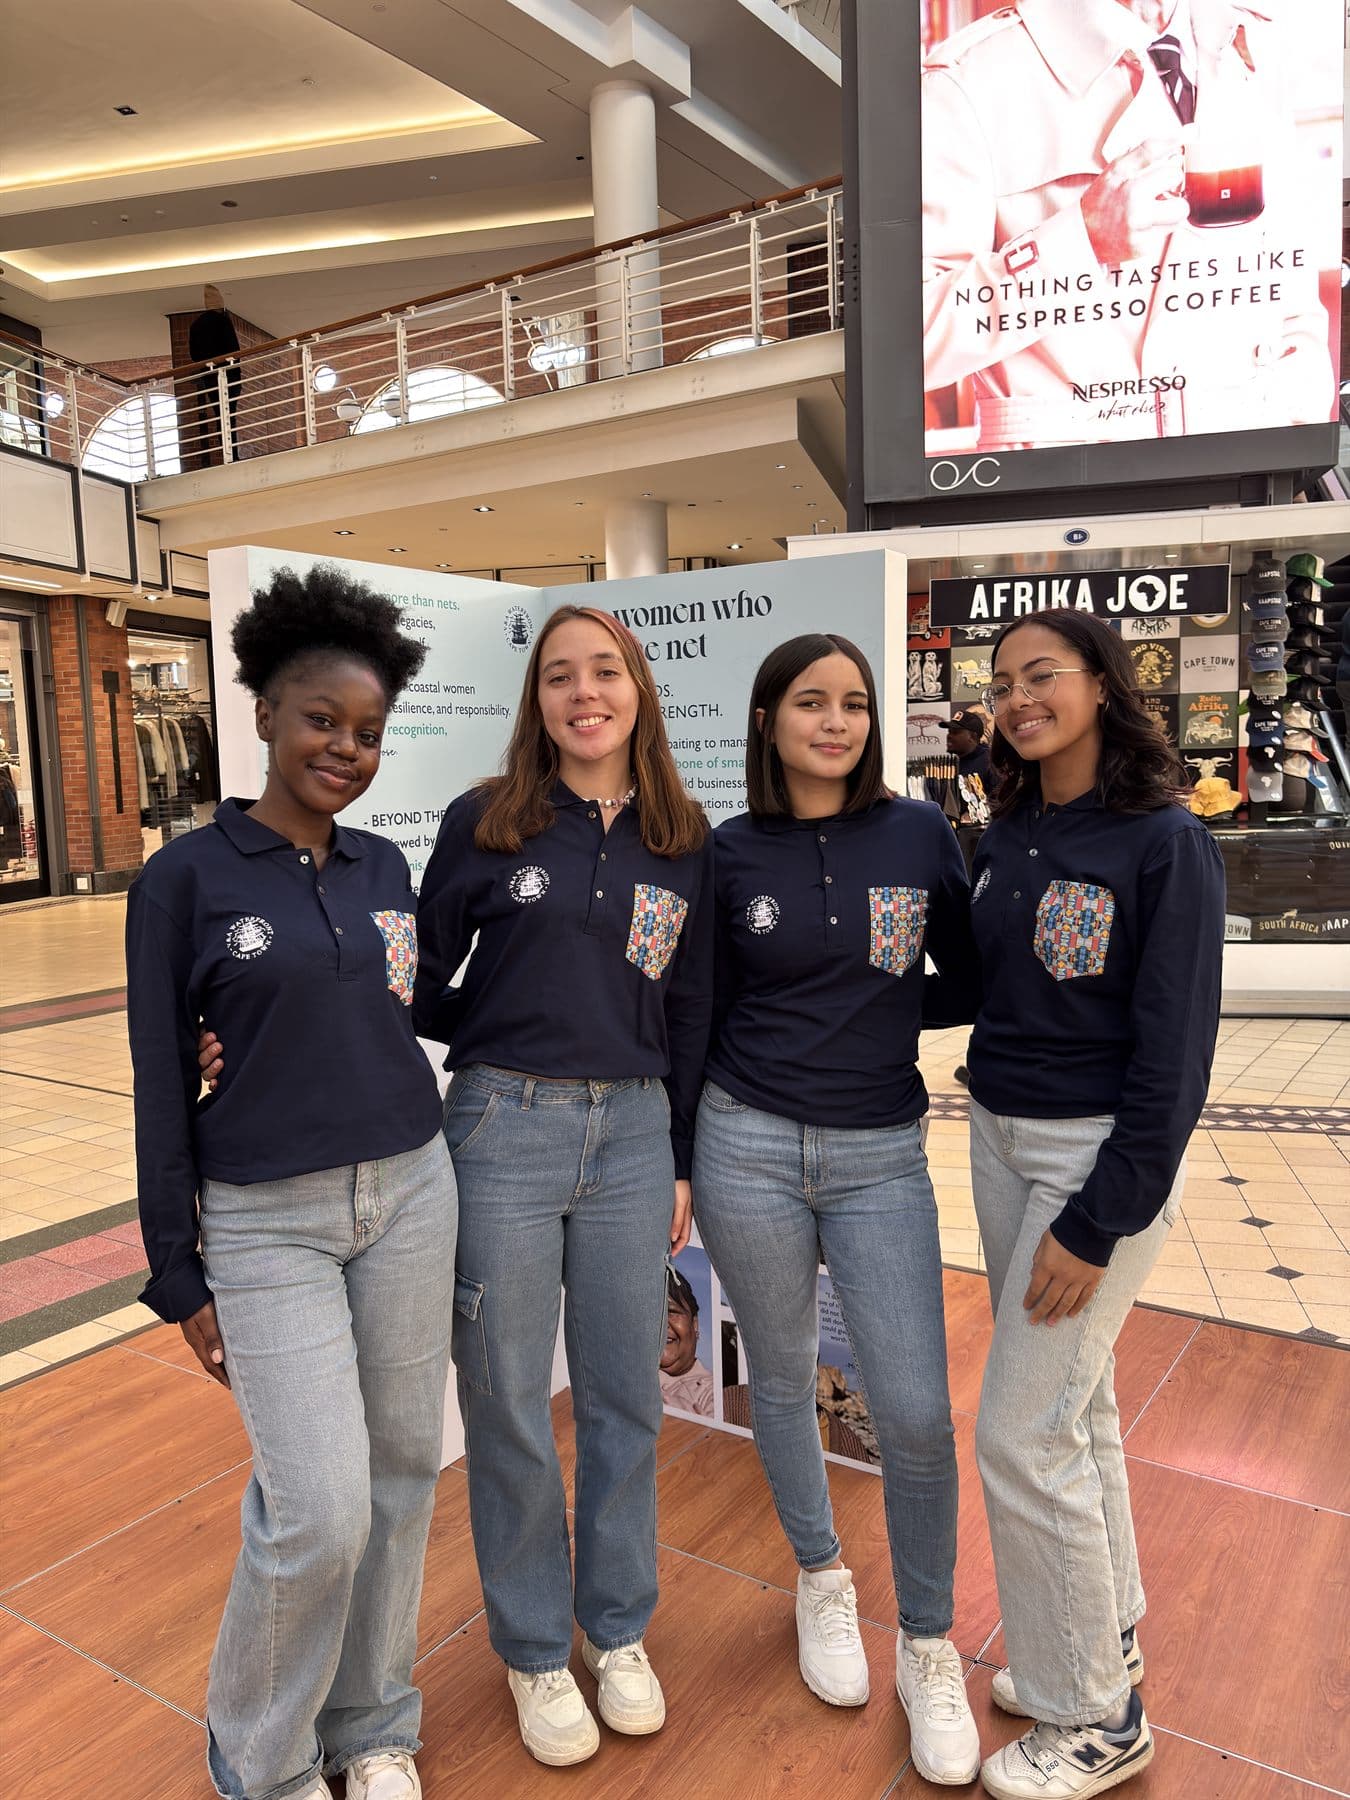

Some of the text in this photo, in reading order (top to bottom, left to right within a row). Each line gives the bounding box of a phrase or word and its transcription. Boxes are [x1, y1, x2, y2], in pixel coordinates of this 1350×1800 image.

[956, 249, 1305, 306] NOTHING TASTES LIKE
[976, 283, 1281, 334] NESPRESSO COFFEE
[1067, 374, 1187, 403] NESPRESSO
[412, 593, 434, 607] than
[437, 600, 460, 611] nets.
[969, 573, 1189, 619] AFRIKA JOE
[613, 590, 773, 628] women who
[666, 634, 708, 661] net
[1183, 657, 1207, 669] CAPE
[1210, 656, 1236, 667] TOWN
[408, 681, 475, 694] coastal women
[391, 702, 511, 719] esilience, and responsibility.
[661, 703, 723, 719] RENGTH.
[387, 724, 448, 739] recognition,
[704, 740, 717, 750] to
[706, 757, 719, 769] of
[721, 759, 745, 769] sma
[697, 777, 748, 789] businesse
[372, 811, 422, 827] BEYOND
[424, 835, 436, 850] by
[1259, 918, 1319, 934] SOUTH AFRICA
